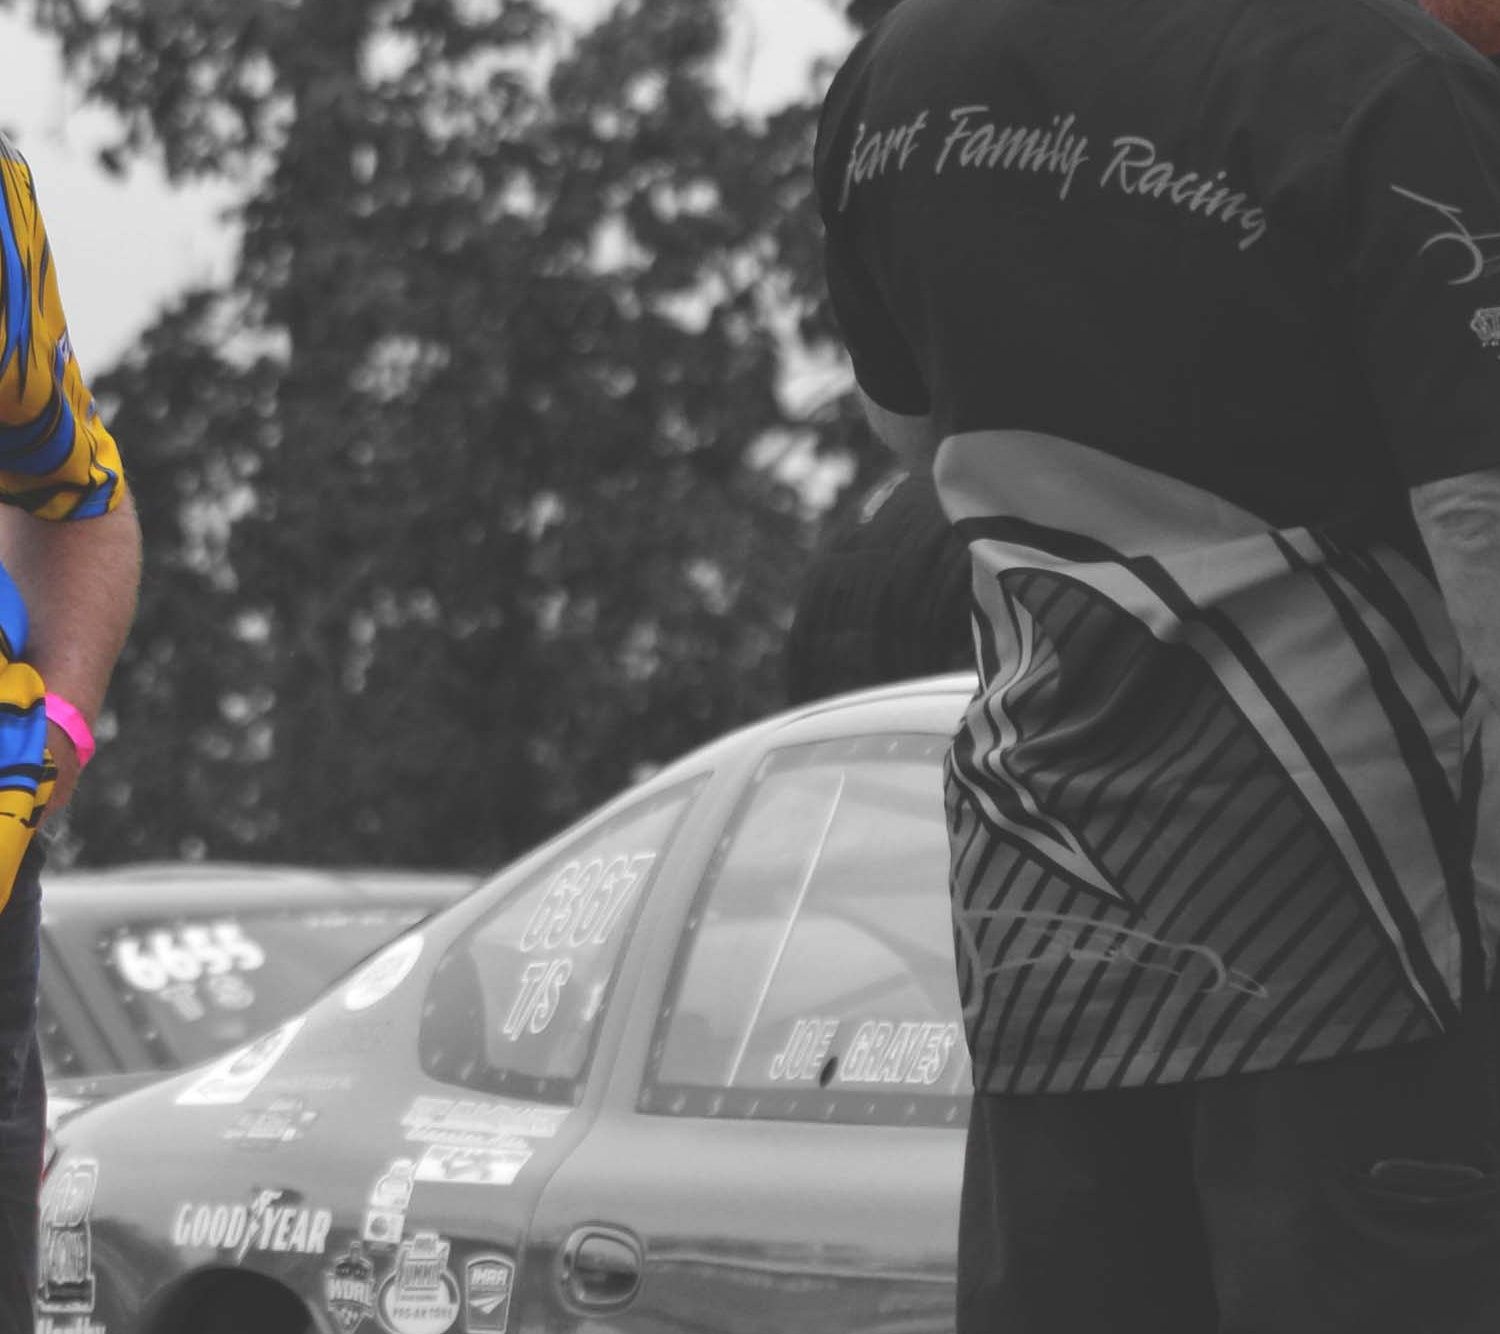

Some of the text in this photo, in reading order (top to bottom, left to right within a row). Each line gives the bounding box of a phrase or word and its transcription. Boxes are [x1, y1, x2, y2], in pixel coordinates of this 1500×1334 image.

[935, 105, 1089, 201] Family
[1100, 135, 1267, 251] Racing
[520, 851, 657, 953] 6367
[117, 923, 264, 991] 6655
[769, 1019, 960, 1086] JOE GRAVES
